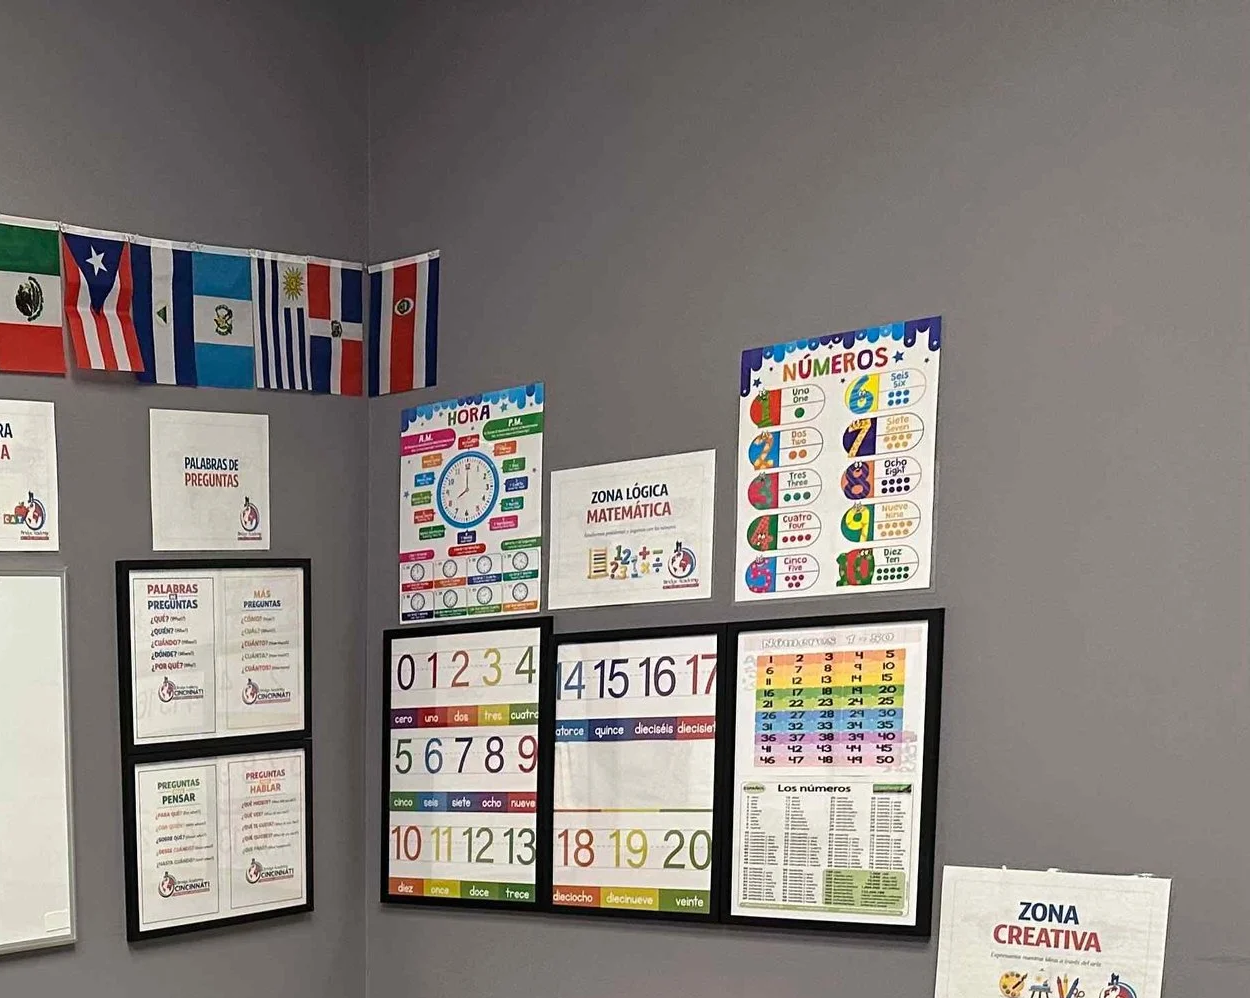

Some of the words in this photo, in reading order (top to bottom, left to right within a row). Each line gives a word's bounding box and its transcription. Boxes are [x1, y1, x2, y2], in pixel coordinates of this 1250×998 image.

[783, 347, 888, 382] NÚMEROS
[890, 372, 909, 381] Seis
[792, 388, 810, 396] Uno
[850, 374, 874, 414] 6
[792, 396, 809, 404] One
[447, 404, 490, 426] HORA
[886, 416, 910, 426] Siete
[848, 420, 872, 458] 7
[184, 457, 227, 470] PALABRAS
[229, 459, 239, 471] DE
[884, 458, 907, 468] Ocho
[185, 472, 239, 488] PREGUNTAS
[789, 471, 807, 480] Tres
[844, 461, 871, 500] 8
[591, 488, 624, 504] ZONA
[626, 482, 668, 499] LÓGICA
[586, 500, 672, 524] MATEMÁTICA
[782, 513, 812, 523] Cuatro
[846, 505, 870, 542] 9
[884, 548, 902, 556] Diez
[784, 556, 807, 565] Cinco
[836, 548, 875, 587] 10
[748, 560, 772, 594] 5
[147, 584, 198, 594] PALABRAS
[254, 589, 271, 598] MÁS
[148, 600, 198, 610] PREGUNTAS
[398, 654, 415, 690] 0
[427, 652, 437, 688] 1
[451, 650, 470, 688] 2
[482, 648, 502, 686] 3
[515, 646, 536, 684] 4
[766, 667, 774, 675] 6
[795, 666, 802, 674] 7
[824, 664, 832, 672] 8
[882, 662, 895, 670] 10
[556, 661, 586, 700] 14
[594, 659, 629, 699] 15
[639, 656, 676, 697] 16
[686, 654, 717, 695] 17
[821, 675, 832, 684] 13
[882, 673, 893, 682] 15
[764, 689, 775, 697] 16
[792, 688, 804, 696] 17
[822, 687, 832, 695] 18
[852, 686, 862, 694] 19
[879, 685, 897, 694] 20
[762, 700, 773, 708] 21
[789, 699, 804, 708] 22
[818, 698, 833, 706] 23
[848, 698, 863, 706] 24
[878, 696, 894, 705] 25
[395, 715, 413, 724] cero
[425, 715, 439, 723] uno
[454, 710, 469, 722] dos
[485, 711, 502, 721] tres
[510, 709, 539, 720] cuatro
[762, 712, 777, 720] 26
[790, 710, 806, 719] 27
[820, 710, 834, 718] 28
[849, 709, 864, 718] 29
[878, 709, 896, 718] 30
[556, 725, 584, 736] atorce
[595, 725, 624, 738] quince
[634, 722, 674, 735] dieciséis
[677, 721, 716, 733] diecisiet
[762, 723, 772, 731] 31
[788, 722, 804, 730] 32
[817, 721, 833, 730] 33
[847, 721, 862, 730] 34
[877, 720, 894, 729] 35
[761, 734, 777, 742] 36
[789, 733, 806, 742] 37
[819, 732, 834, 742] 38
[848, 732, 864, 741] 39
[878, 732, 896, 740] 40
[395, 738, 412, 774] 5
[425, 737, 443, 774] 6
[455, 737, 473, 773] 7
[484, 736, 504, 773] 8
[518, 735, 538, 773] 9
[787, 745, 802, 753] 42
[816, 744, 832, 752] 43
[876, 744, 892, 752] 45
[760, 756, 776, 764] 46
[788, 756, 804, 764] 47
[818, 756, 833, 764] 48
[876, 756, 894, 764] 50
[246, 769, 286, 780] PREGUNTAS
[158, 778, 200, 790] PREGUNTAS
[250, 783, 281, 794] HABLAR
[777, 784, 797, 793] Los
[800, 784, 851, 793] números
[162, 793, 196, 805] PENSAR
[394, 798, 413, 807] cinco
[423, 798, 439, 807] seis
[452, 797, 471, 808] siete
[482, 796, 502, 808] ocho
[510, 799, 536, 808] nueve
[392, 825, 422, 861] 10
[431, 826, 452, 862] 11
[462, 827, 494, 863] 12
[503, 828, 536, 865] 13
[558, 829, 595, 867] 18
[609, 829, 648, 868] 19
[663, 830, 712, 871] 20
[175, 881, 210, 892] CINCINNATI
[398, 882, 414, 893] diez
[430, 887, 449, 895] once
[469, 886, 490, 897] doce
[506, 888, 529, 899] trece
[553, 890, 593, 903] dieciocho
[606, 892, 653, 905] diecinueve
[676, 897, 703, 907] veinte
[1018, 901, 1080, 926] ZONA
[993, 924, 1102, 953] CREATIVA
